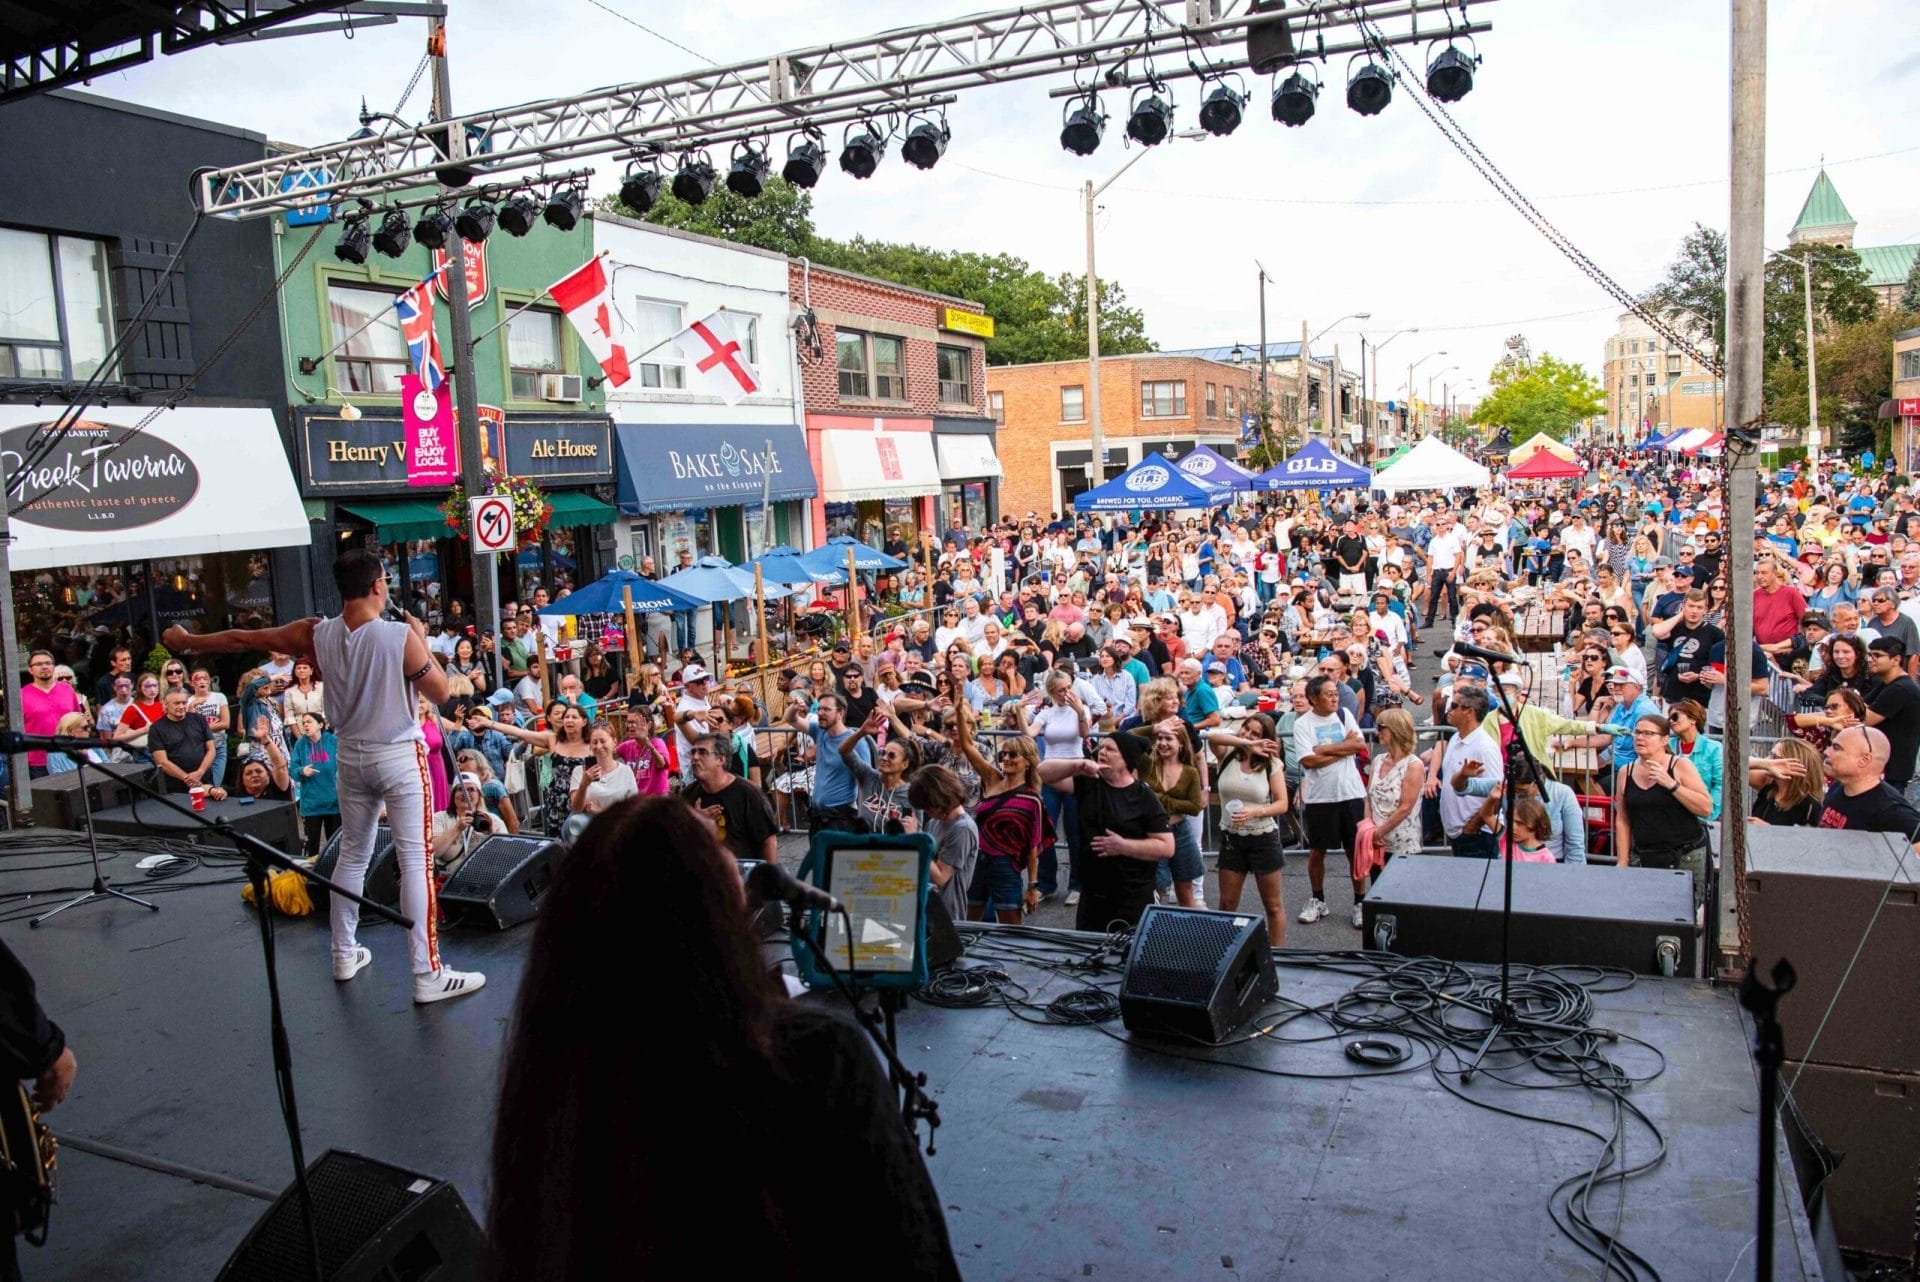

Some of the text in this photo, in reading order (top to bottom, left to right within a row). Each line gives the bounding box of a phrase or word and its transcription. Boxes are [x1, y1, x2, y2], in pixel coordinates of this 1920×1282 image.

[89, 429, 110, 438] HUT
[418, 427, 439, 438] BUY
[327, 440, 389, 467] Henry
[414, 446, 447, 458] ENJOY
[531, 439, 598, 458] Ale House
[82, 442, 186, 489] Taverna
[415, 457, 448, 468] LOCAL
[668, 451, 724, 480] BAKE
[1286, 457, 1338, 473] GLB
[731, 480, 765, 492] Kingswa
[27, 500, 87, 512] authentic
[91, 498, 120, 509] taste
[125, 496, 136, 506] of
[1153, 495, 1184, 505] ONTARIO
[841, 558, 882, 568] PRONI
